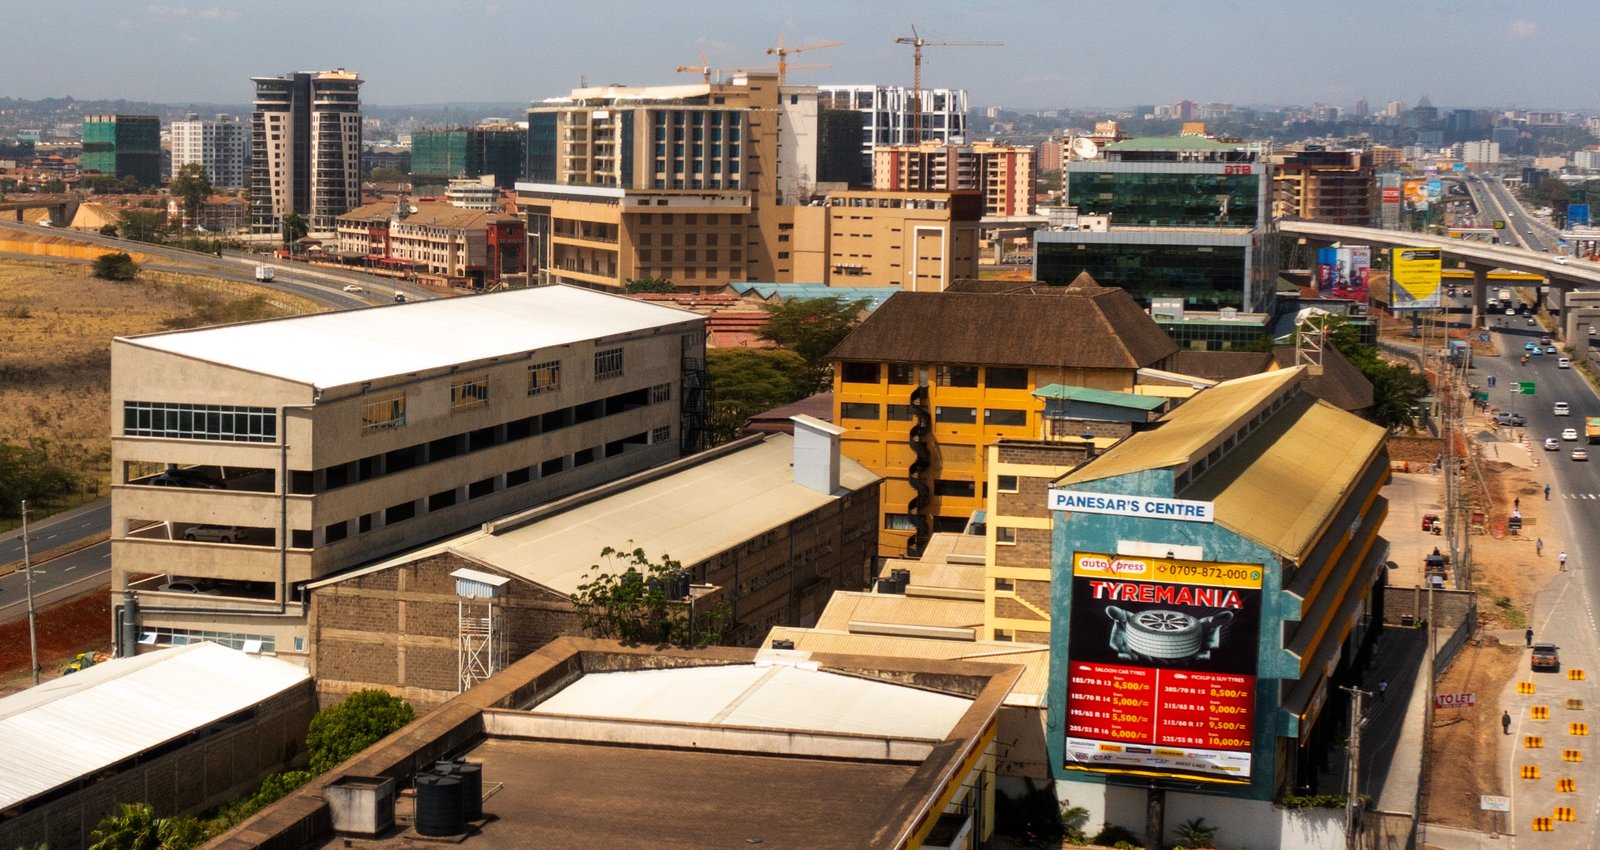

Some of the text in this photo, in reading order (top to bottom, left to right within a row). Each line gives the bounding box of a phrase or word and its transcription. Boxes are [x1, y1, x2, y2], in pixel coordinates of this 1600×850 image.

[1224, 165, 1252, 175] DTB
[1056, 494, 1205, 517] PANESAR'S CENTRE
[1169, 565, 1248, 579] 0709-872-000
[1089, 581, 1243, 609] TYREMANIA
[1114, 681, 1150, 690] 4,500/=
[1210, 688, 1248, 698] 8,500/=
[1113, 698, 1149, 706] 5,000/=
[1440, 694, 1472, 704] TO LET
[1209, 705, 1247, 714] 9,000/=
[1112, 714, 1148, 723] 5,500/=
[1209, 721, 1246, 730] 9,500/=
[1111, 730, 1148, 739] 6,000/=
[1209, 737, 1251, 746] 10,000/=
